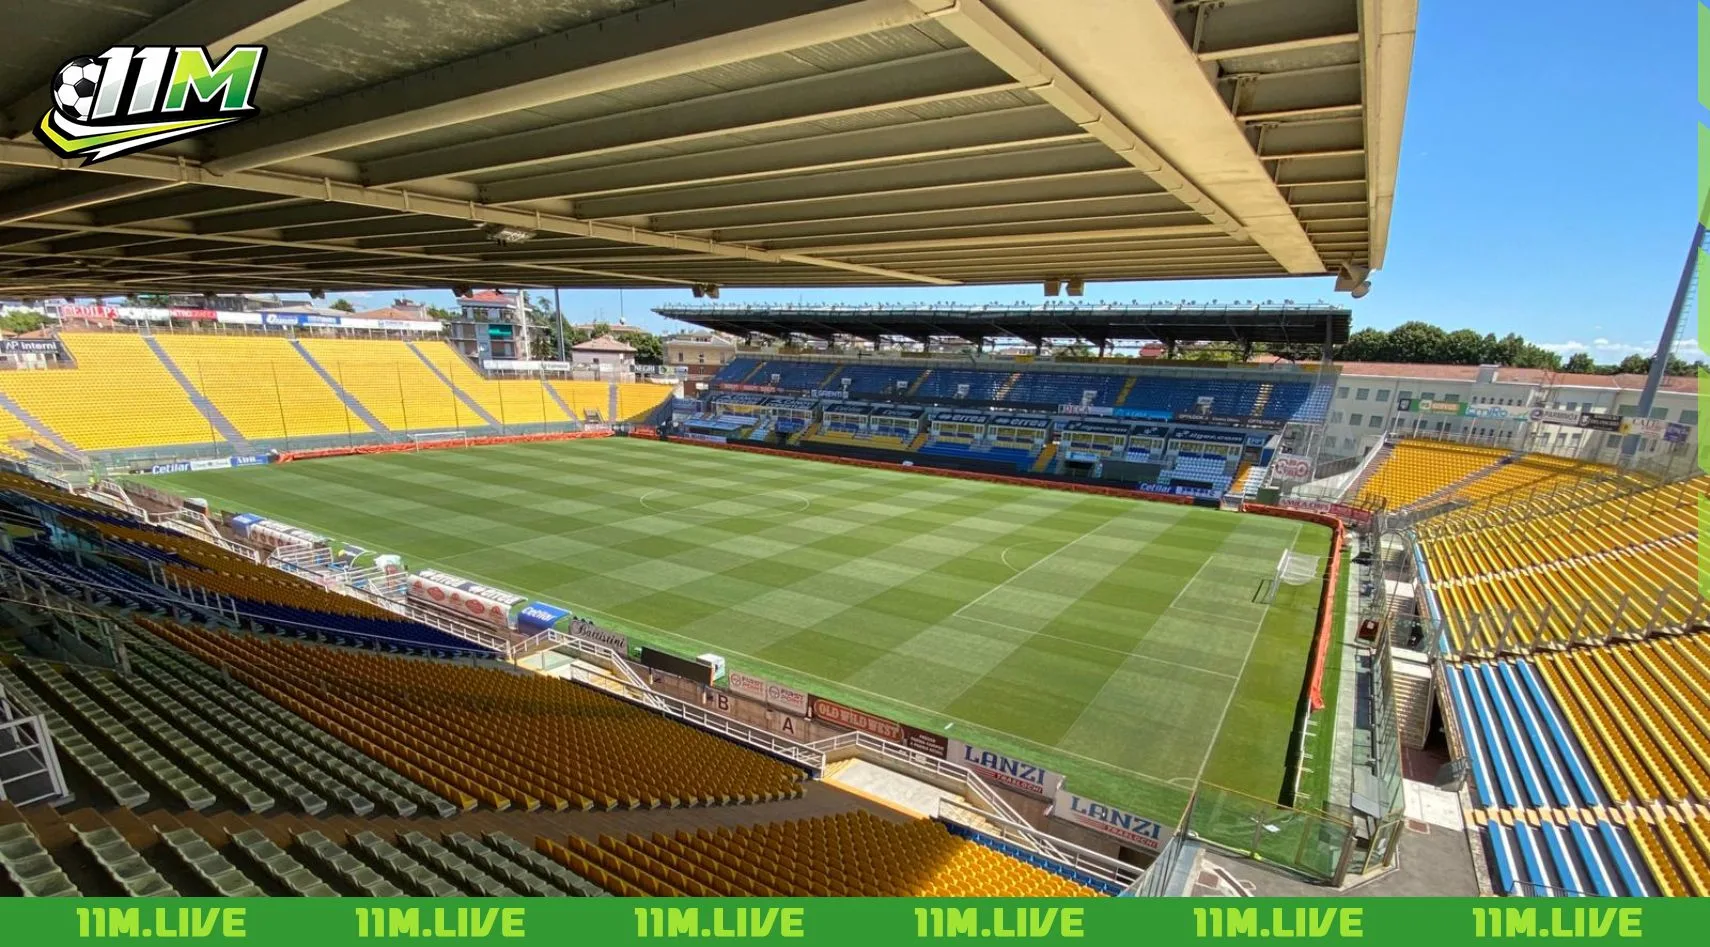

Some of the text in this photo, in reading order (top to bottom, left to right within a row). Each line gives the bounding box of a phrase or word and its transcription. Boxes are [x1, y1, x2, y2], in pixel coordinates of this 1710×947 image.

[152, 462, 190, 475] Cetilar
[718, 694, 729, 710] B
[782, 717, 794, 734] A
[819, 703, 899, 739] OLD WILD WEST
[964, 745, 1045, 785] LANZI
[1071, 796, 1161, 840] LANZI
